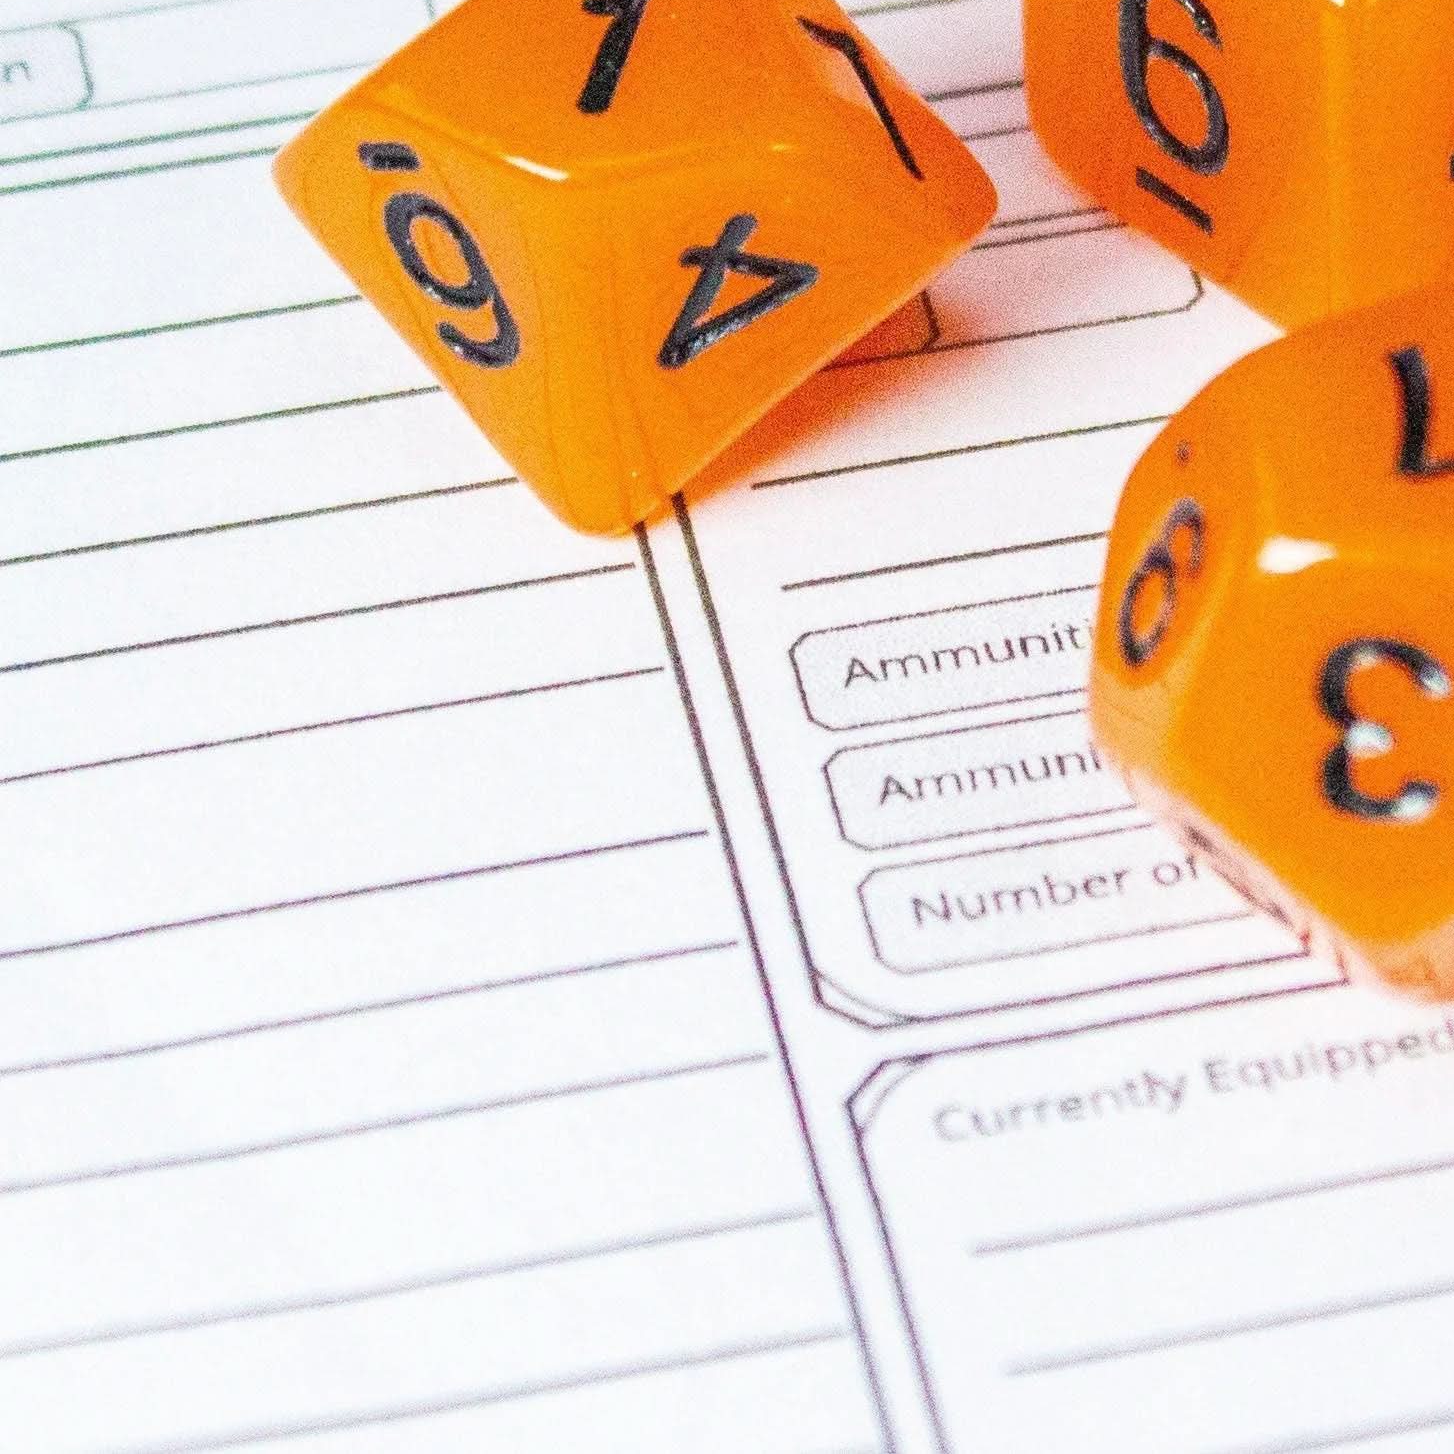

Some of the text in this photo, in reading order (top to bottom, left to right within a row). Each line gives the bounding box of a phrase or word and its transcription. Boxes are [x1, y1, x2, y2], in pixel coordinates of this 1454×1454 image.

[657, 212, 820, 369] 4
[1315, 636, 1454, 824] 3
[911, 869, 1130, 929] Number
[932, 1068, 1188, 1144] Currently
